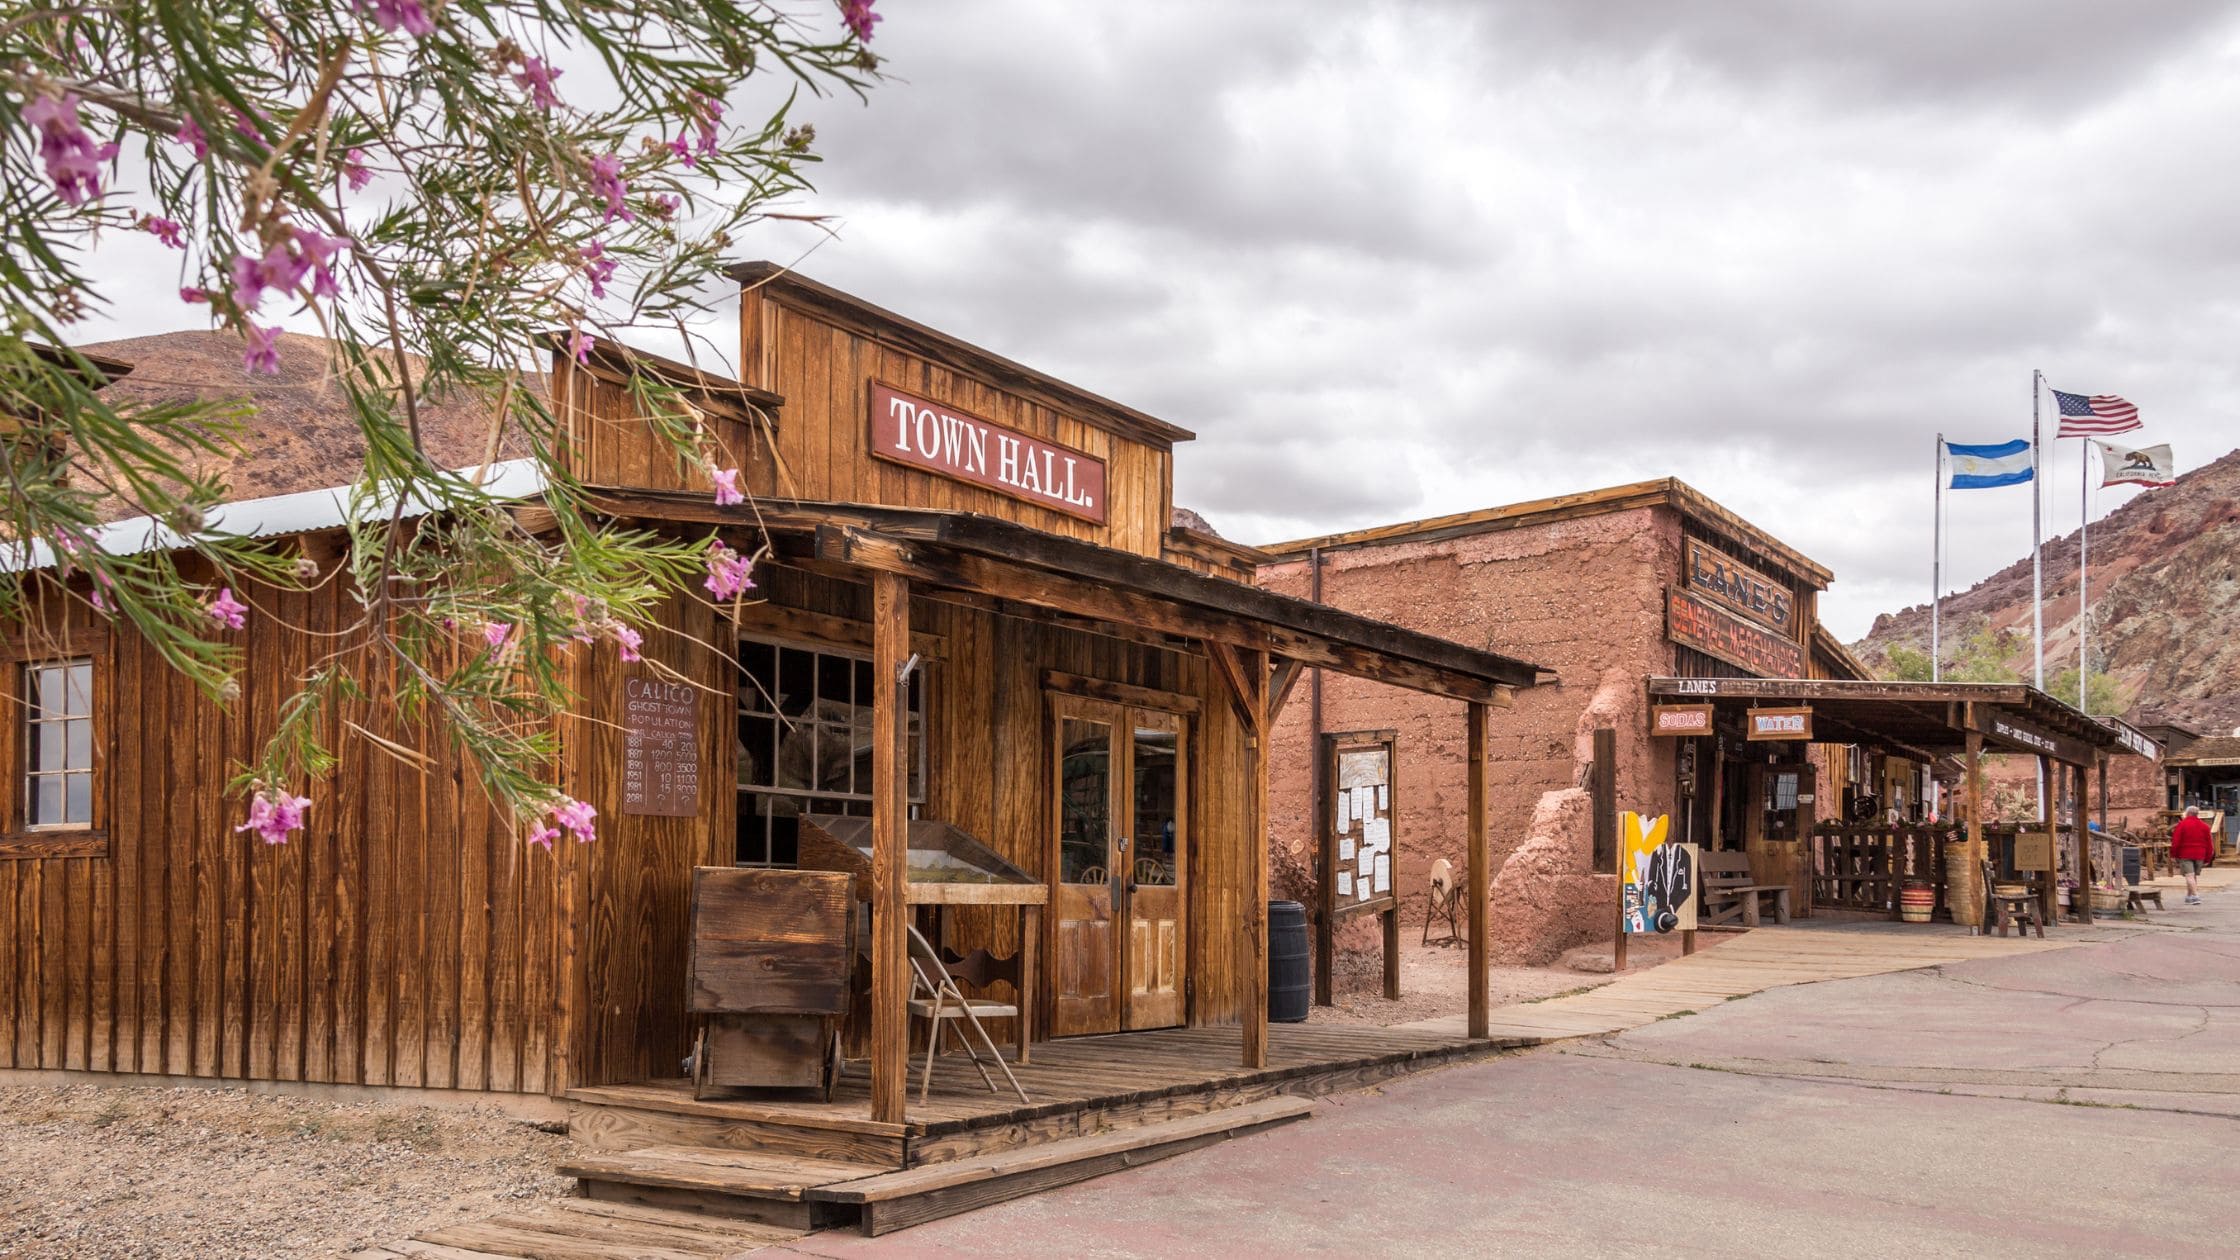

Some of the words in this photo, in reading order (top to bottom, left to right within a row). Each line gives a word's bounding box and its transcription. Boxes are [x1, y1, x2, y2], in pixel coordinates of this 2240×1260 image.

[890, 397, 988, 476] TOWN
[998, 434, 1093, 508] HALL.
[1692, 546, 1790, 624] LANE'S
[1671, 595, 1724, 650] GENERAL
[628, 679, 694, 705] CALICO
[1678, 680, 1717, 694] LANES
[1778, 682, 1822, 696] STORE
[628, 700, 660, 712] GHOST
[662, 703, 692, 716] TOWN
[1659, 712, 1706, 728] SODAS
[1756, 715, 1805, 732] WATER
[627, 736, 642, 747] 1881
[662, 739, 673, 749] 40
[681, 742, 697, 752] 200
[627, 749, 643, 759] 1887
[651, 749, 673, 760] 1200
[676, 751, 697, 762] 5000
[627, 760, 643, 770] 1890
[654, 761, 672, 772] 800
[676, 762, 697, 773] 3500
[627, 770, 642, 780] 1951
[661, 773, 672, 783] 10
[677, 774, 697, 784] 1100
[627, 781, 642, 791] 1981
[661, 783, 671, 794] 15
